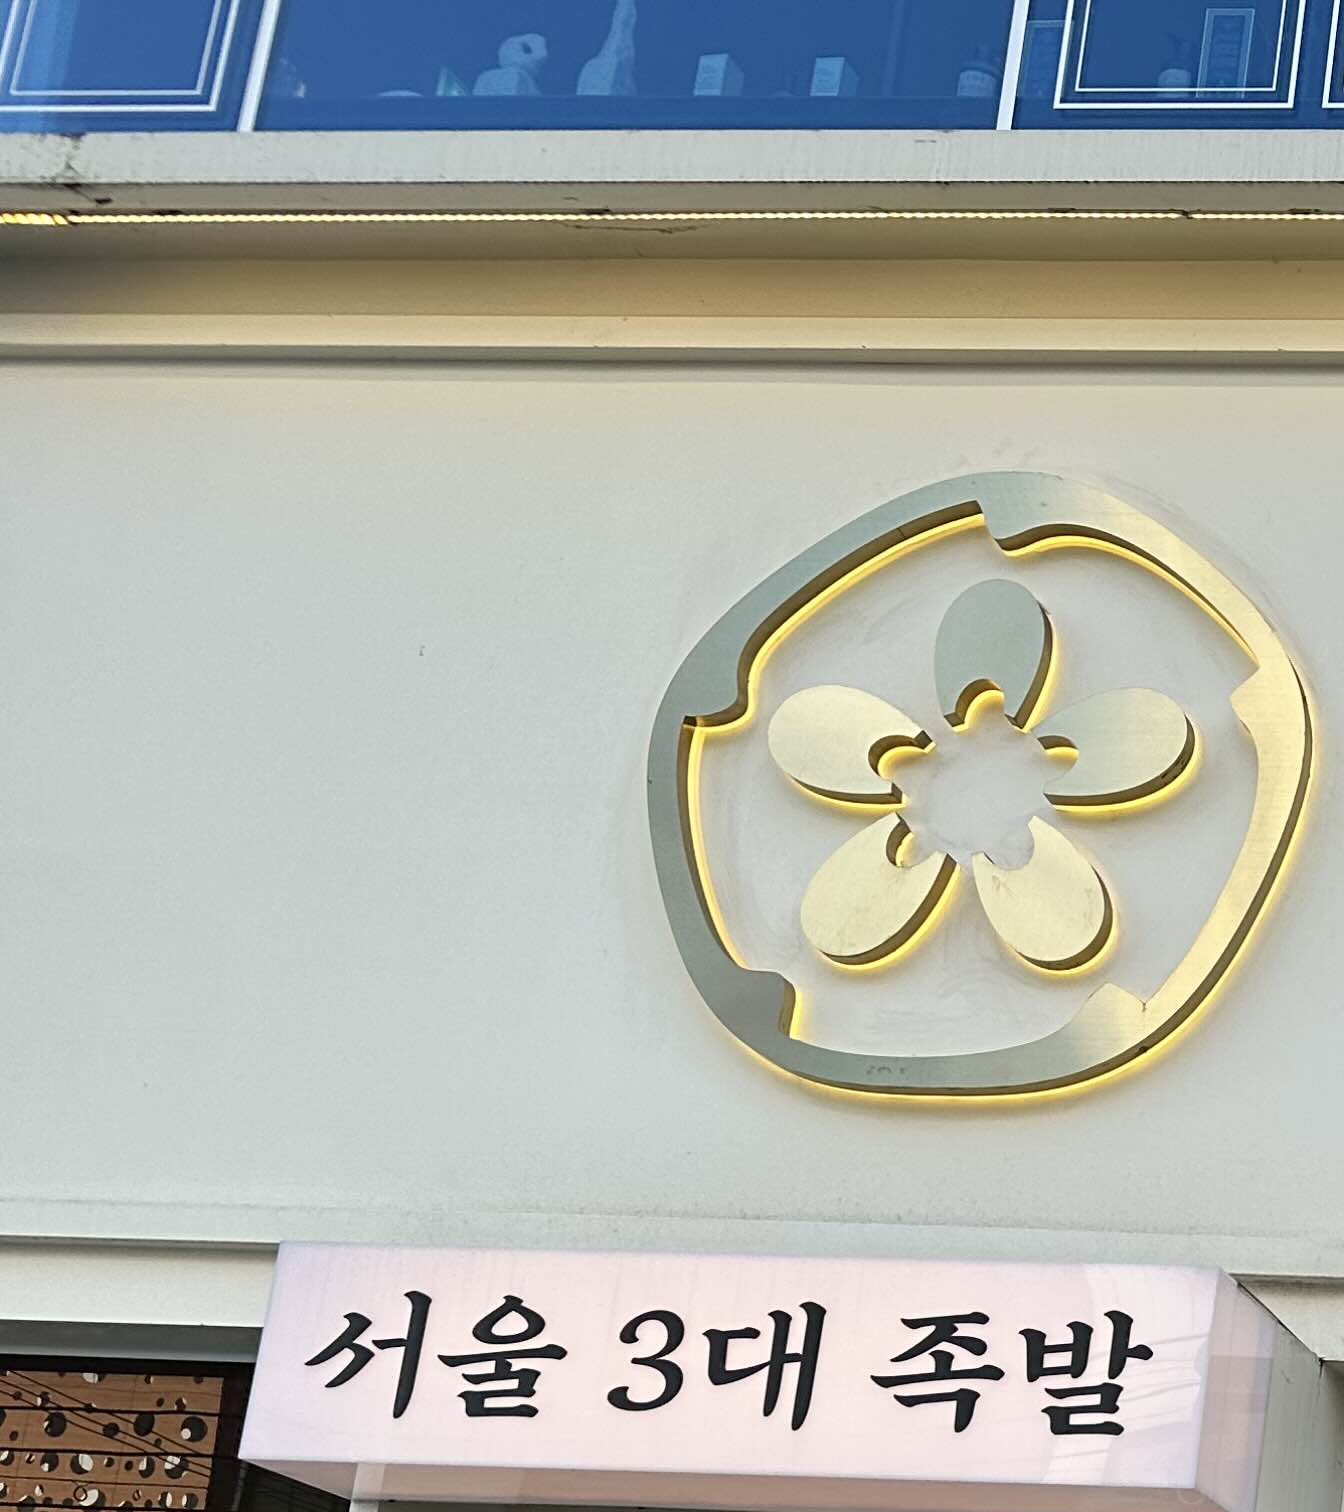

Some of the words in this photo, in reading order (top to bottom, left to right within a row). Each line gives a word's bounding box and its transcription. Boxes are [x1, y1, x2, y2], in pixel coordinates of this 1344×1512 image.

[304, 1290, 568, 1420] 서울
[605, 1300, 827, 1431] 3대
[869, 1309, 1154, 1436] 족발
